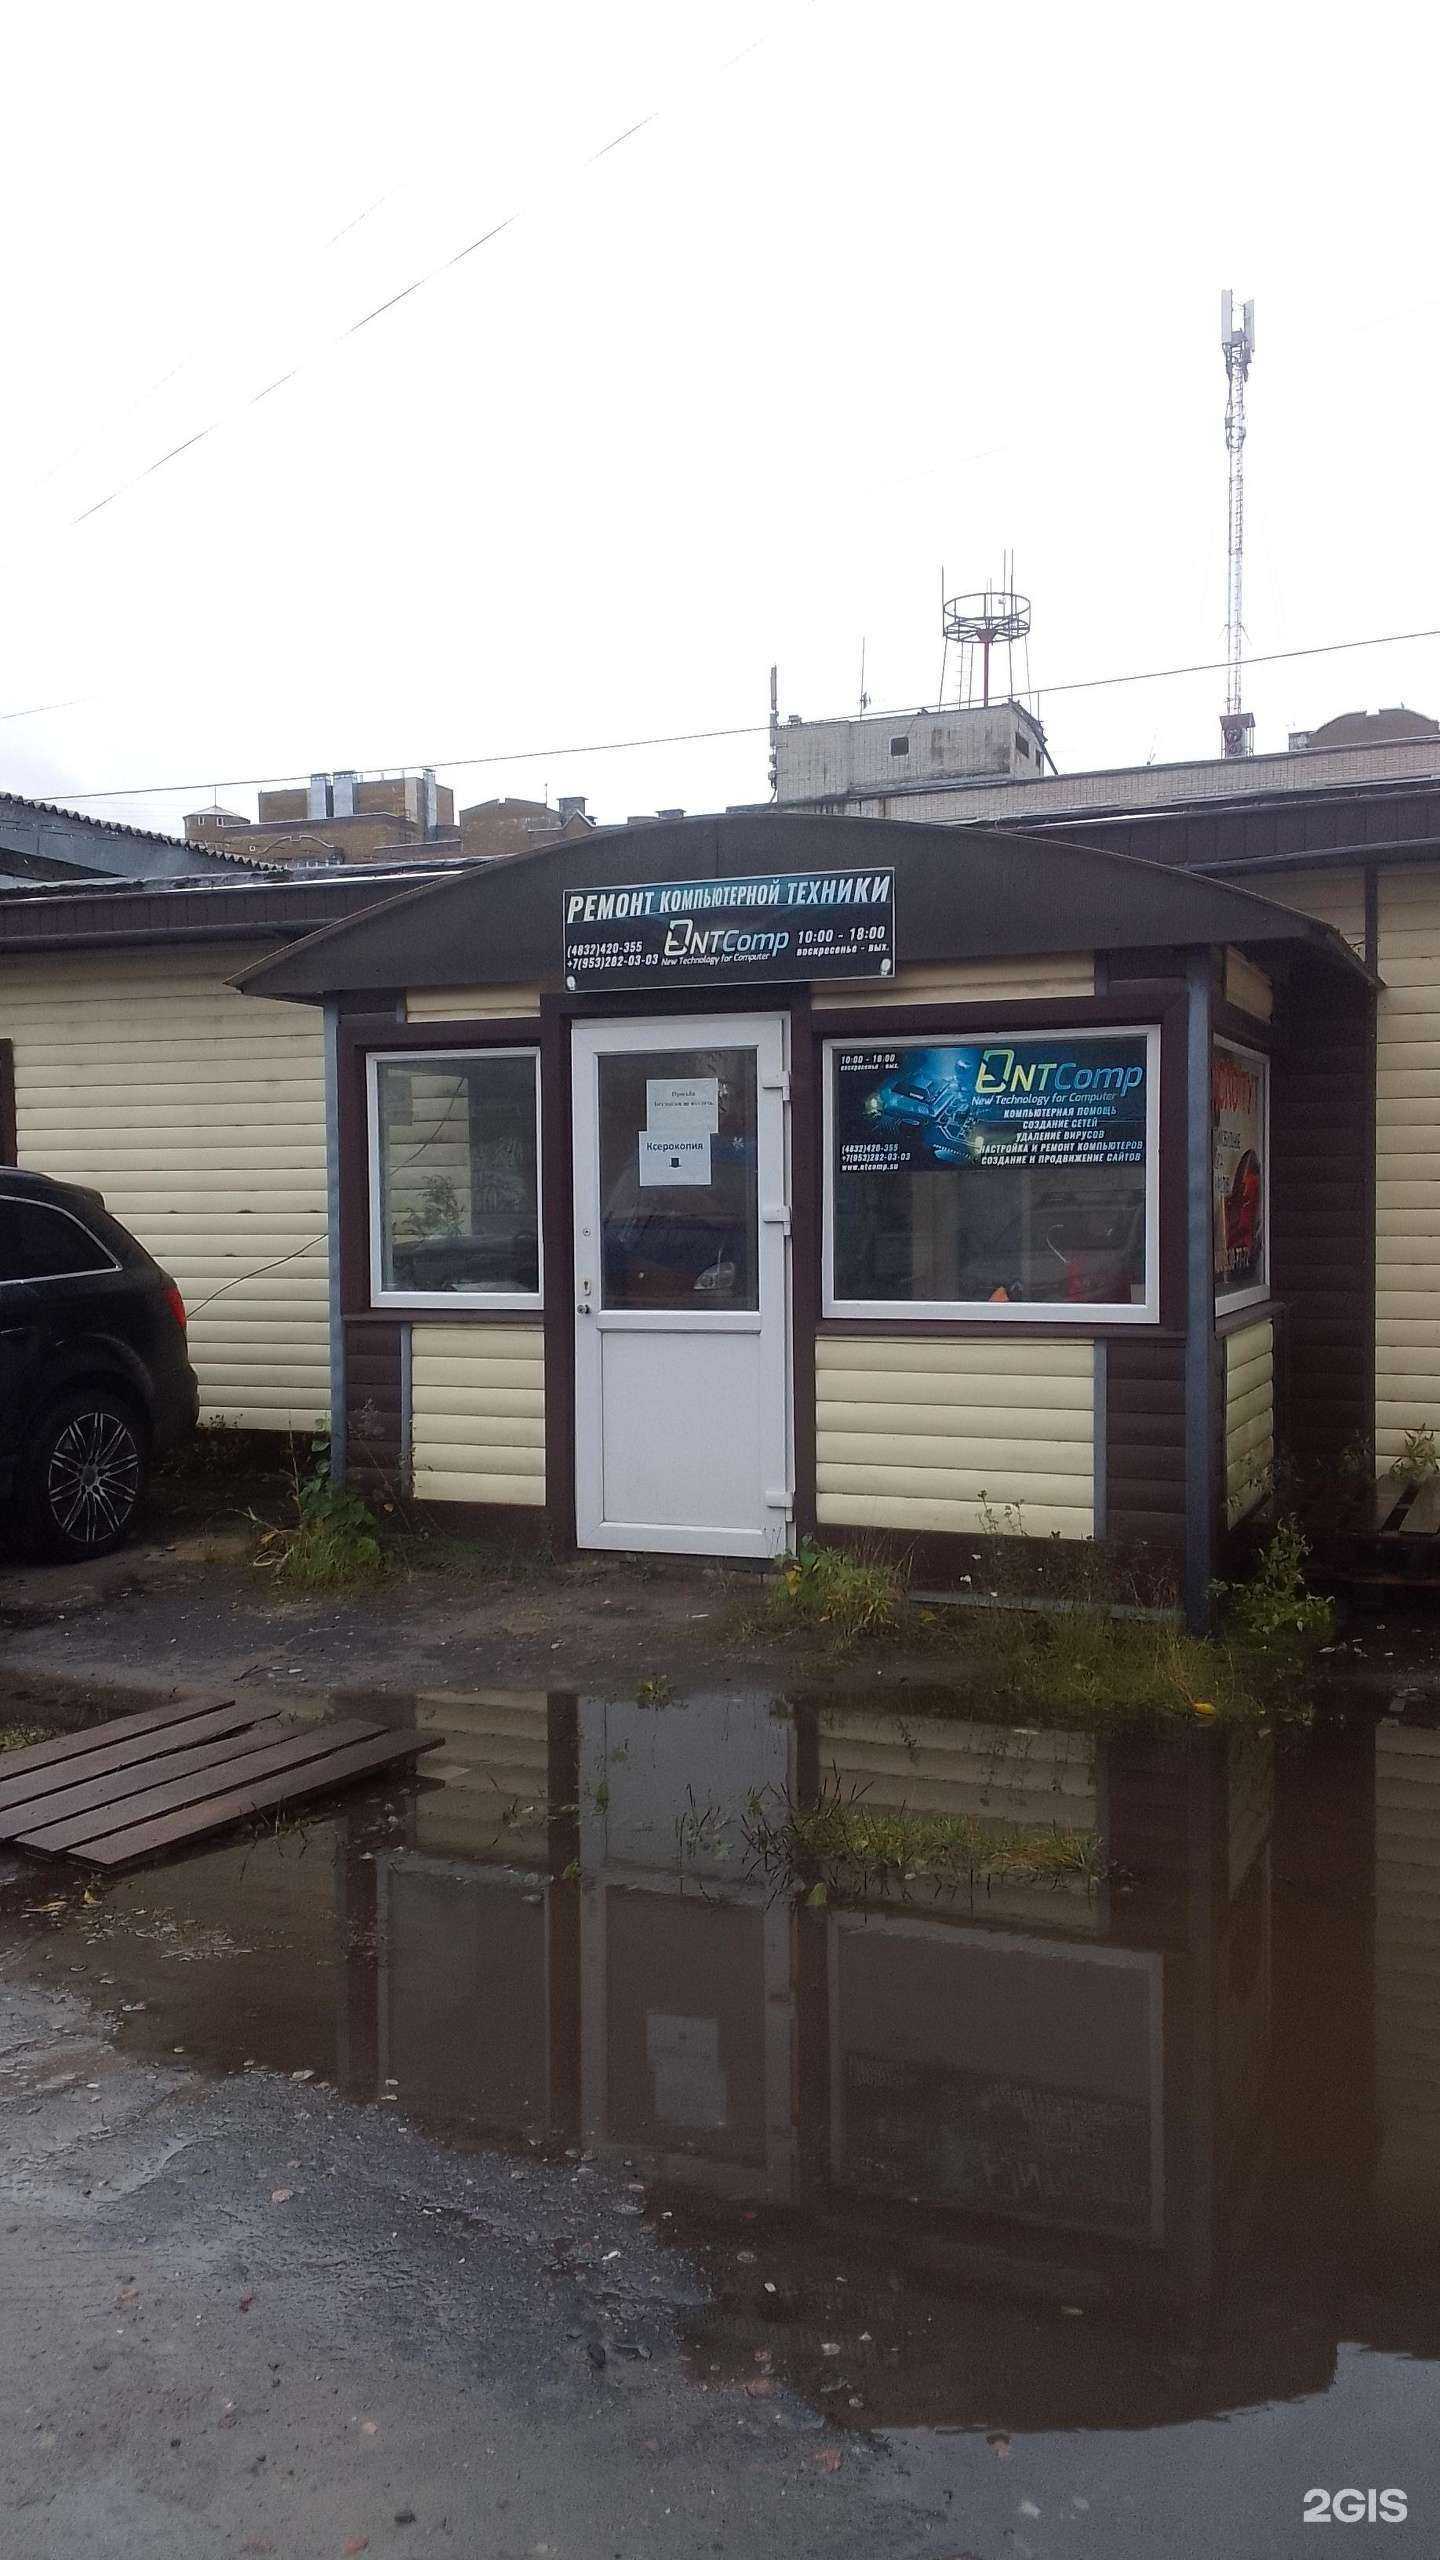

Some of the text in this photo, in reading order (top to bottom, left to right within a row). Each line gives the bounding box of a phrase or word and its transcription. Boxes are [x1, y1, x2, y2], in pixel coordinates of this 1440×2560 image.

[567, 875, 891, 924] РЕМОНТ КОМПЬЮТЕРНОЙ ТЕХНИКИ
[797, 928, 834, 945] 10:00
[848, 925, 886, 942] 18:00
[567, 941, 643, 958] (4832)420-355
[661, 952, 770, 967] New Technology for Computer
[971, 1091, 1117, 1107] New Technology for Computer
[1003, 1106, 1117, 1119] КОМПЬЮТЕРНАЯ ПОМОЩЬ
[1022, 1117, 1098, 1130] СОЗДАНИЕ СЕТЕЙ
[1016, 1129, 1105, 1143] УДАЛЕНИЕ ВИРУСОВ
[646, 1142, 704, 1152] Ксерокопия
[981, 1140, 1144, 1154] НАСТРОЙКА И РЕМОНТ КОМПЬЮТЕРОВ
[981, 1155, 1027, 1166] СОЗДАНИЕ
[1037, 1153, 1104, 1164] ПРОДВИЖЕНИЕ
[1106, 1151, 1142, 1162] САЙТОВ
